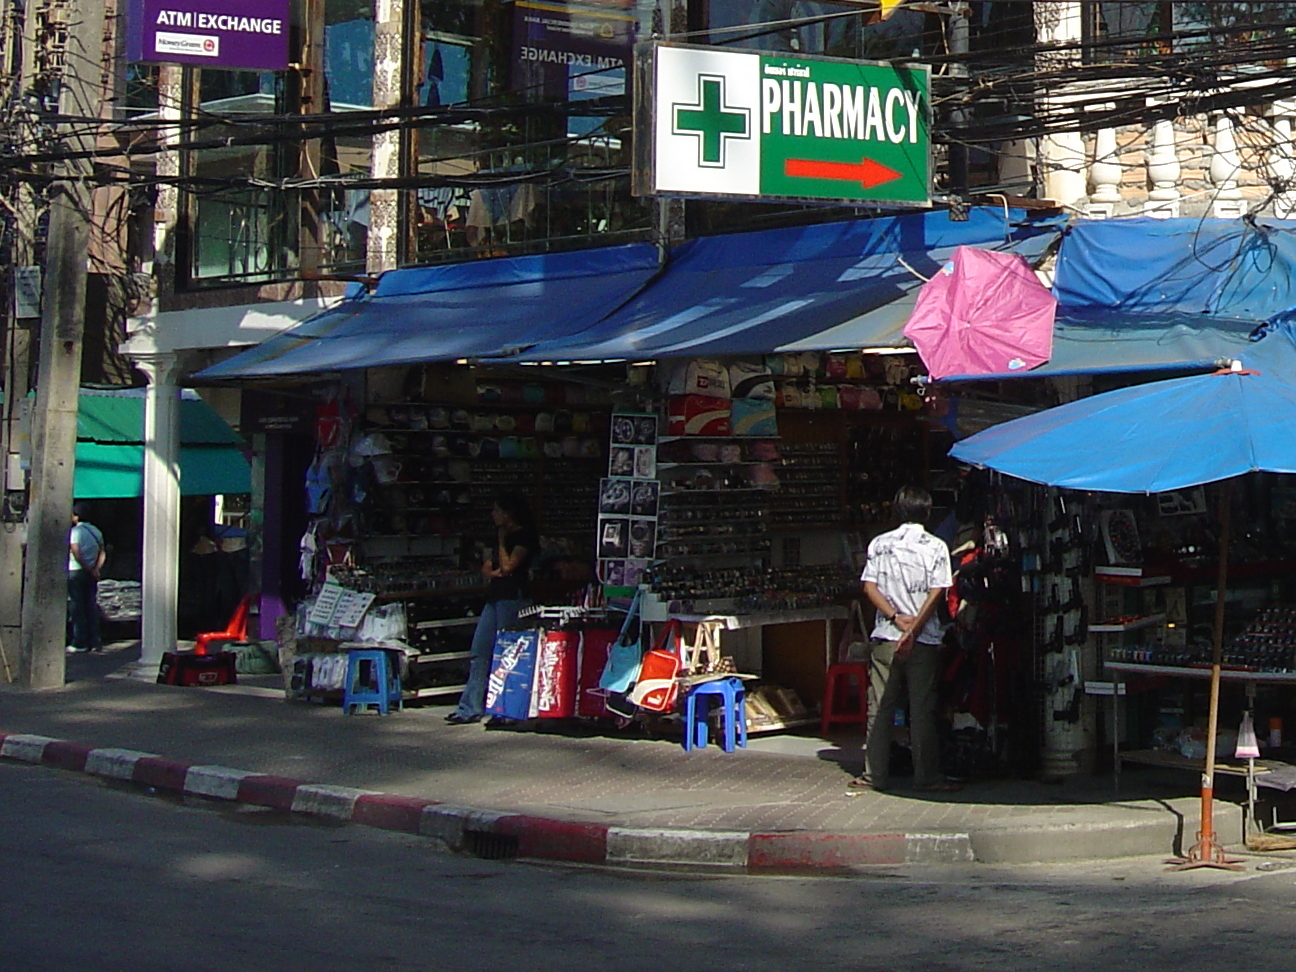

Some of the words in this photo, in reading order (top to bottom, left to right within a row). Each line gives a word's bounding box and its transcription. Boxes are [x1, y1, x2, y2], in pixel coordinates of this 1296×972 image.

[156, 10, 192, 27] ATM
[198, 12, 282, 35] EXCHANGE
[762, 78, 922, 145] PHARMACY
